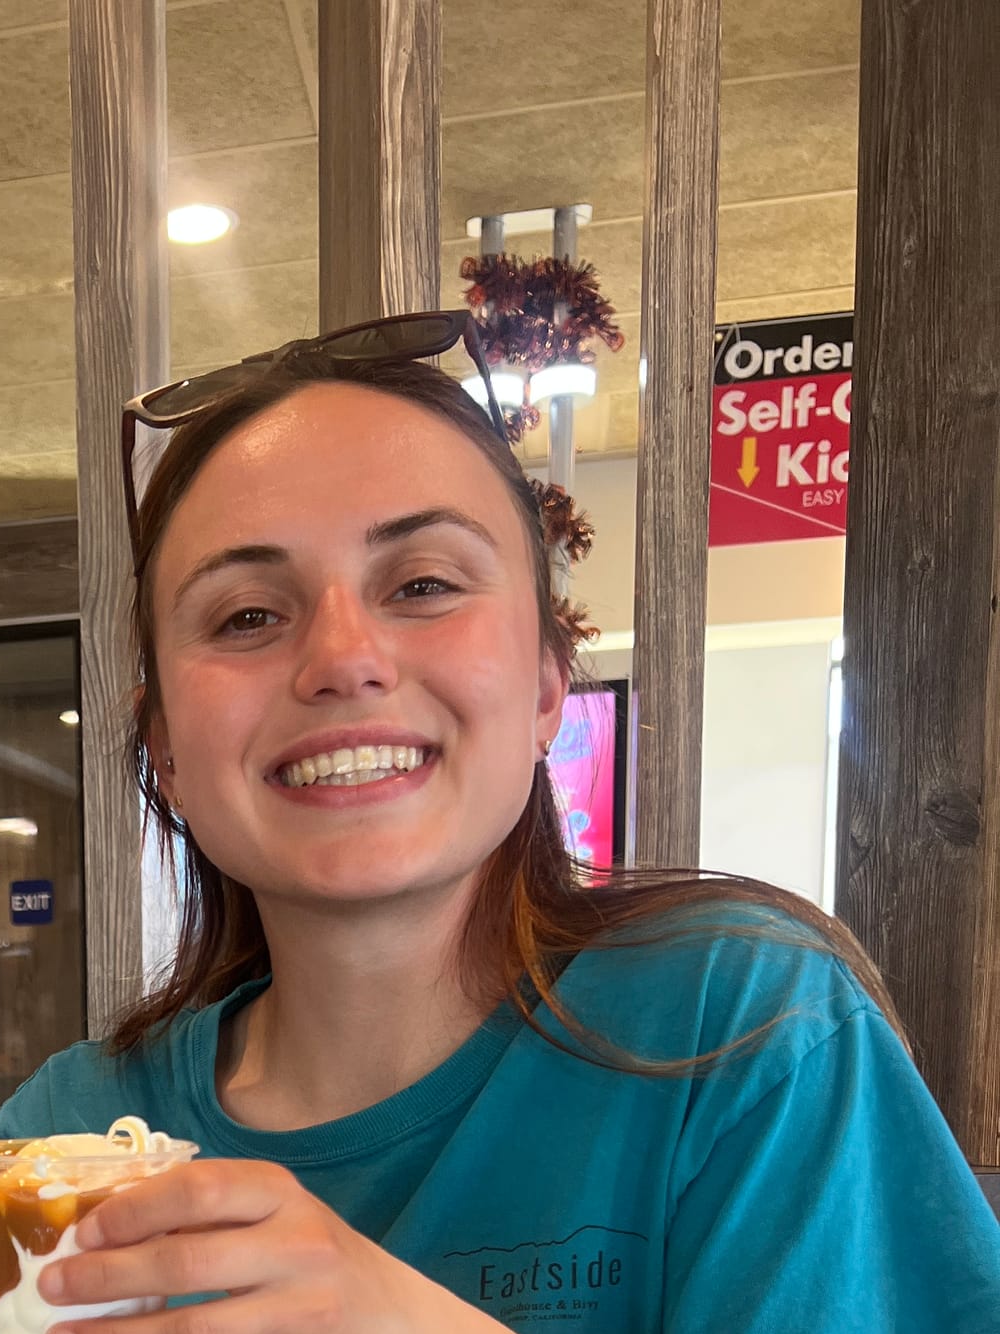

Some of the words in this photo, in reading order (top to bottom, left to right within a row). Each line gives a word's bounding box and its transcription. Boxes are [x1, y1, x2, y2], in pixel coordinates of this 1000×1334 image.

[802, 489, 845, 507] EASY
[11, 893, 51, 911] EXIT
[479, 1250, 622, 1301] Eastside
[556, 1300, 567, 1310] &
